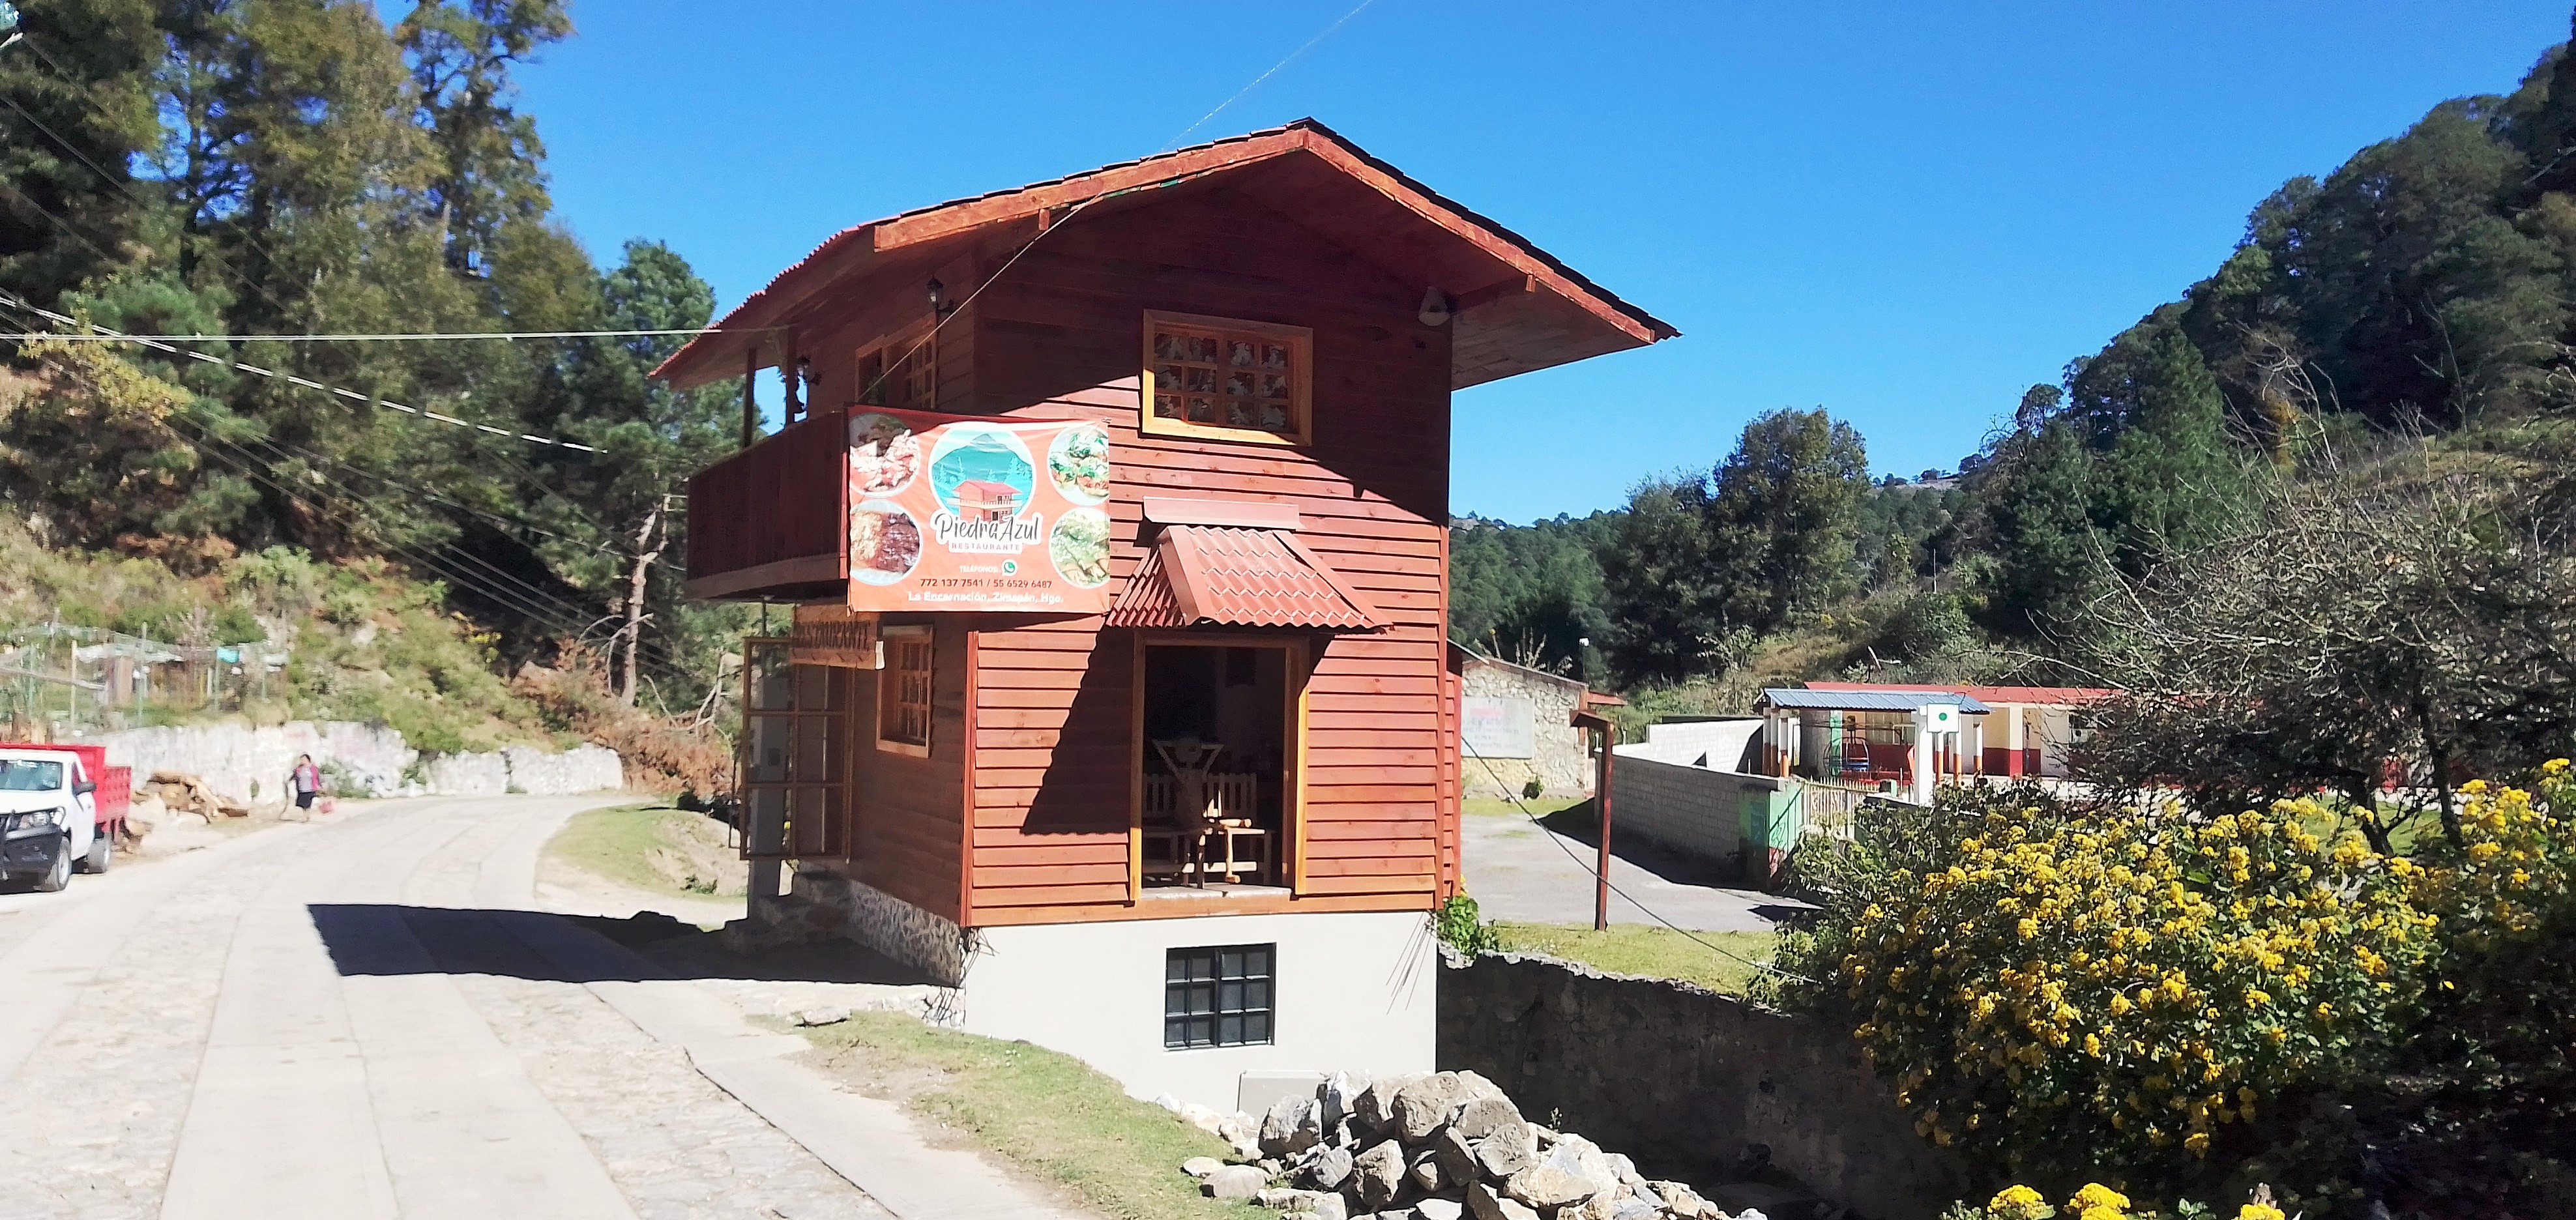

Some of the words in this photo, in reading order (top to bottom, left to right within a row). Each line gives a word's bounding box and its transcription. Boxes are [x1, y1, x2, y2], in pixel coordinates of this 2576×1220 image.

[934, 513, 999, 540] Piedra
[999, 516, 1039, 542] Azul
[951, 542, 1020, 551] RESTAURANTE
[920, 578, 938, 587] 772
[941, 578, 958, 587] 137
[961, 578, 984, 587] 7541
[993, 579, 1004, 588] 55
[1007, 579, 1029, 588] 6529
[1031, 579, 1053, 588] 6487
[908, 591, 922, 601] La
[1040, 592, 1064, 605] Hgo.
